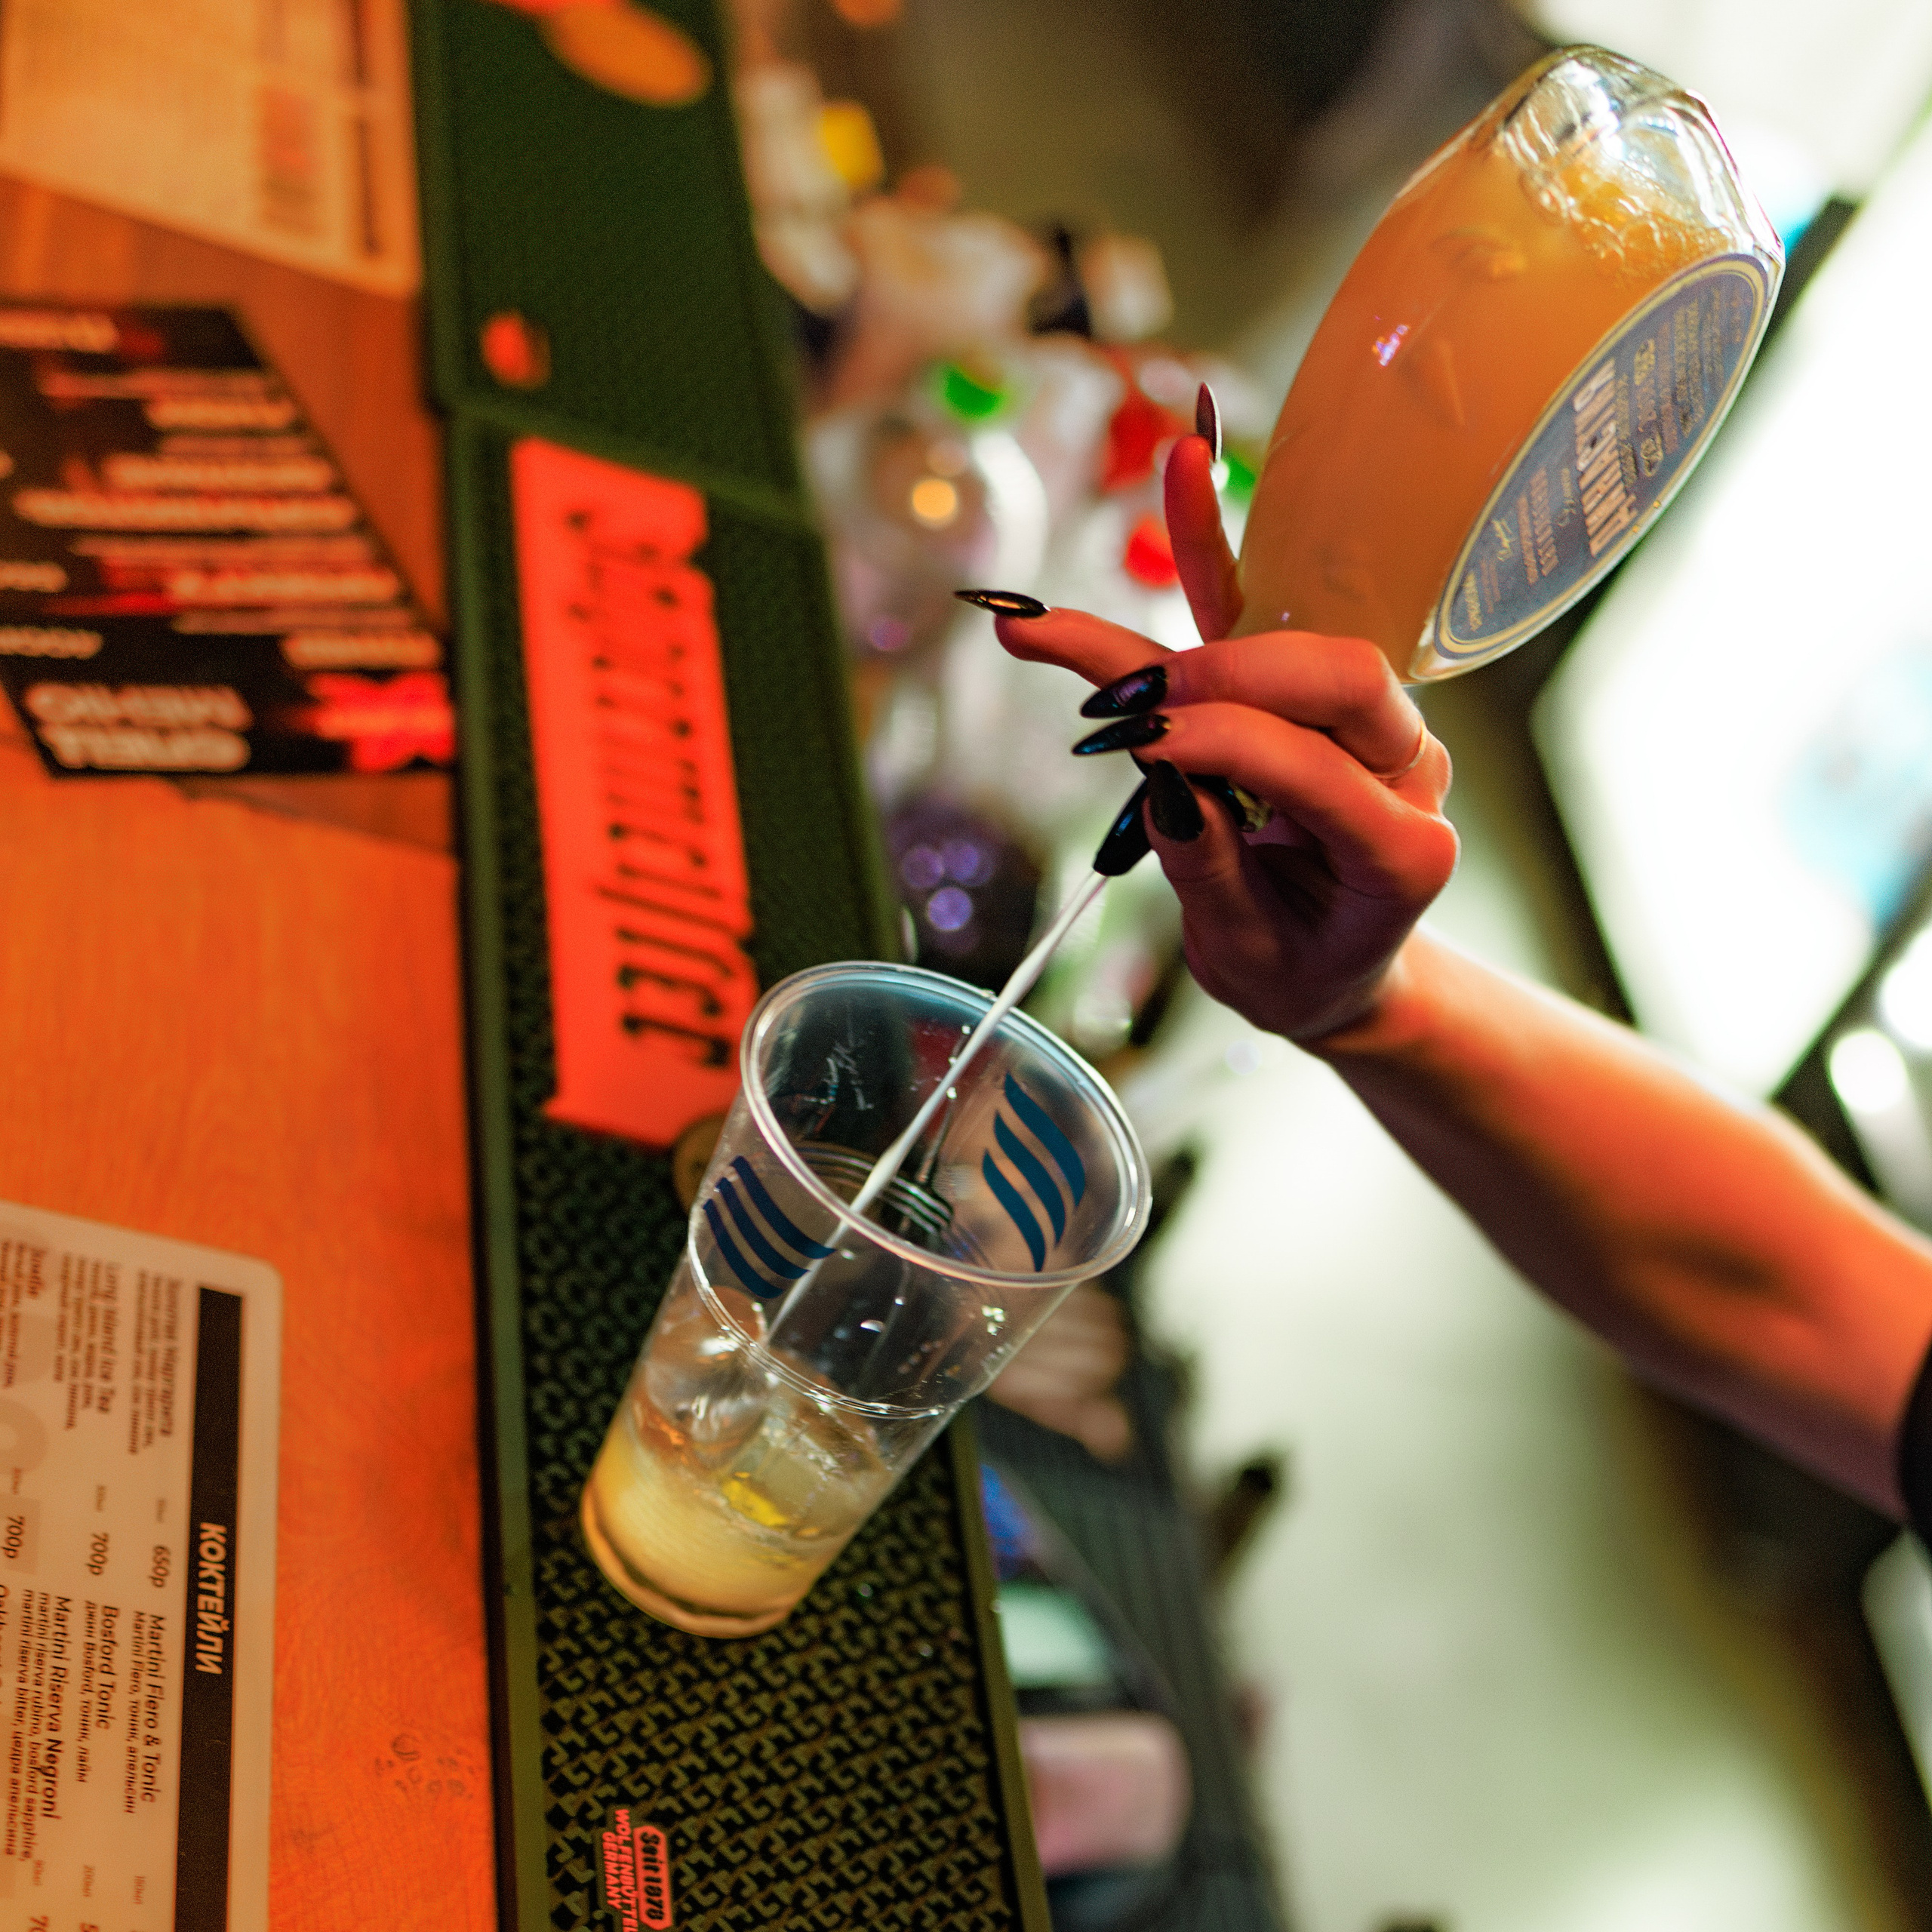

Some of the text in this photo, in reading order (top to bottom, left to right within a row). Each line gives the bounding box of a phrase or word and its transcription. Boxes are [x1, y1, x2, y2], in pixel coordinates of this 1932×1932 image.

[1574, 358, 1637, 557] ДИНАСТИЯ
[20, 1589, 34, 1636] martini
[36, 1592, 53, 1640] martini
[195, 1521, 229, 1675] КОКТЕЙЛИ
[16, 1640, 32, 1684] riserva
[32, 1643, 51, 1686] riserva
[75, 1600, 98, 1783] джин Bosford, тоник, лайм
[96, 1605, 120, 1730] Bosford Tonic
[28, 1690, 47, 1736] rubino,
[39, 1596, 72, 1820] Martini Riserva Negroni
[125, 1611, 146, 1813] Martini Fiero, тоник, апельсин
[140, 1614, 166, 1802] Martini Fiero & Tonic
[8, 1730, 23, 1774] цедра
[5, 1777, 21, 1855] апельсина
[602, 1832, 623, 1909] GERMANY
[641, 1832, 664, 1920] Seit 1878
